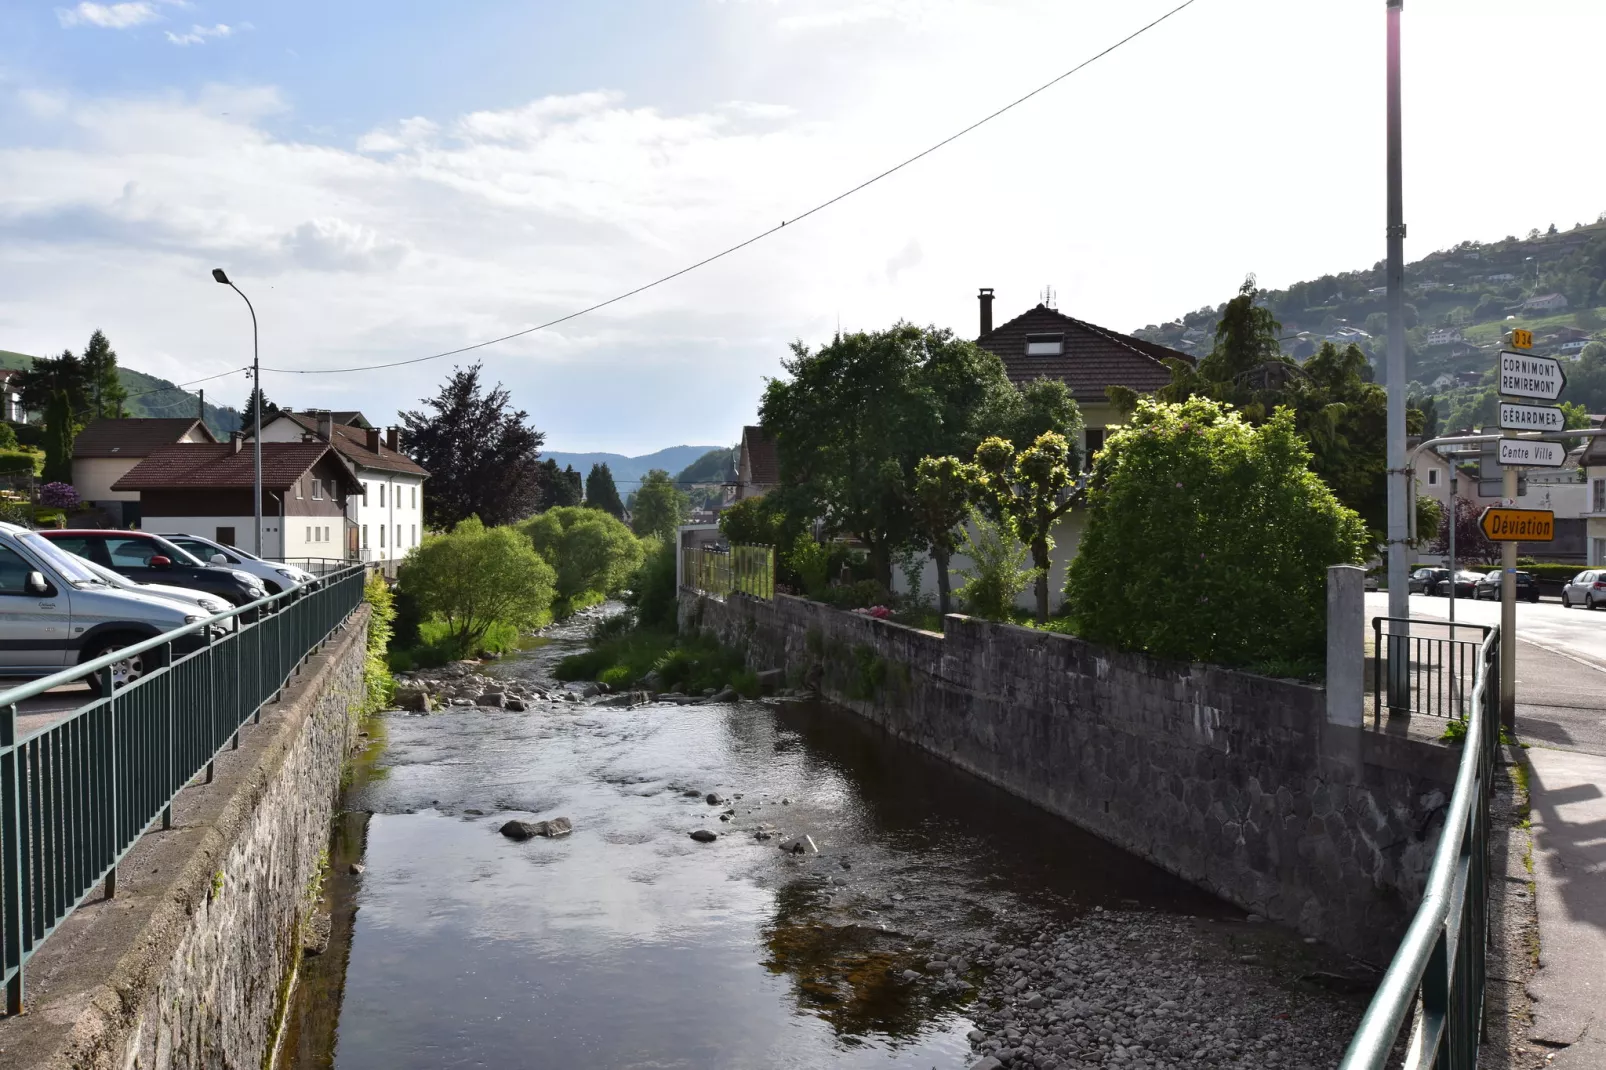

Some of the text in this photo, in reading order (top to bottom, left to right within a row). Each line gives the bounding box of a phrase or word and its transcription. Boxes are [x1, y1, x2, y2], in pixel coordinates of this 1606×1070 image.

[1503, 358, 1555, 376] CORNIMONT
[1503, 375, 1555, 394] REMIREMONT
[1503, 407, 1557, 426] GÉRARDMER
[1502, 445, 1553, 461] Centre Ville
[1492, 514, 1550, 536] Déviation
